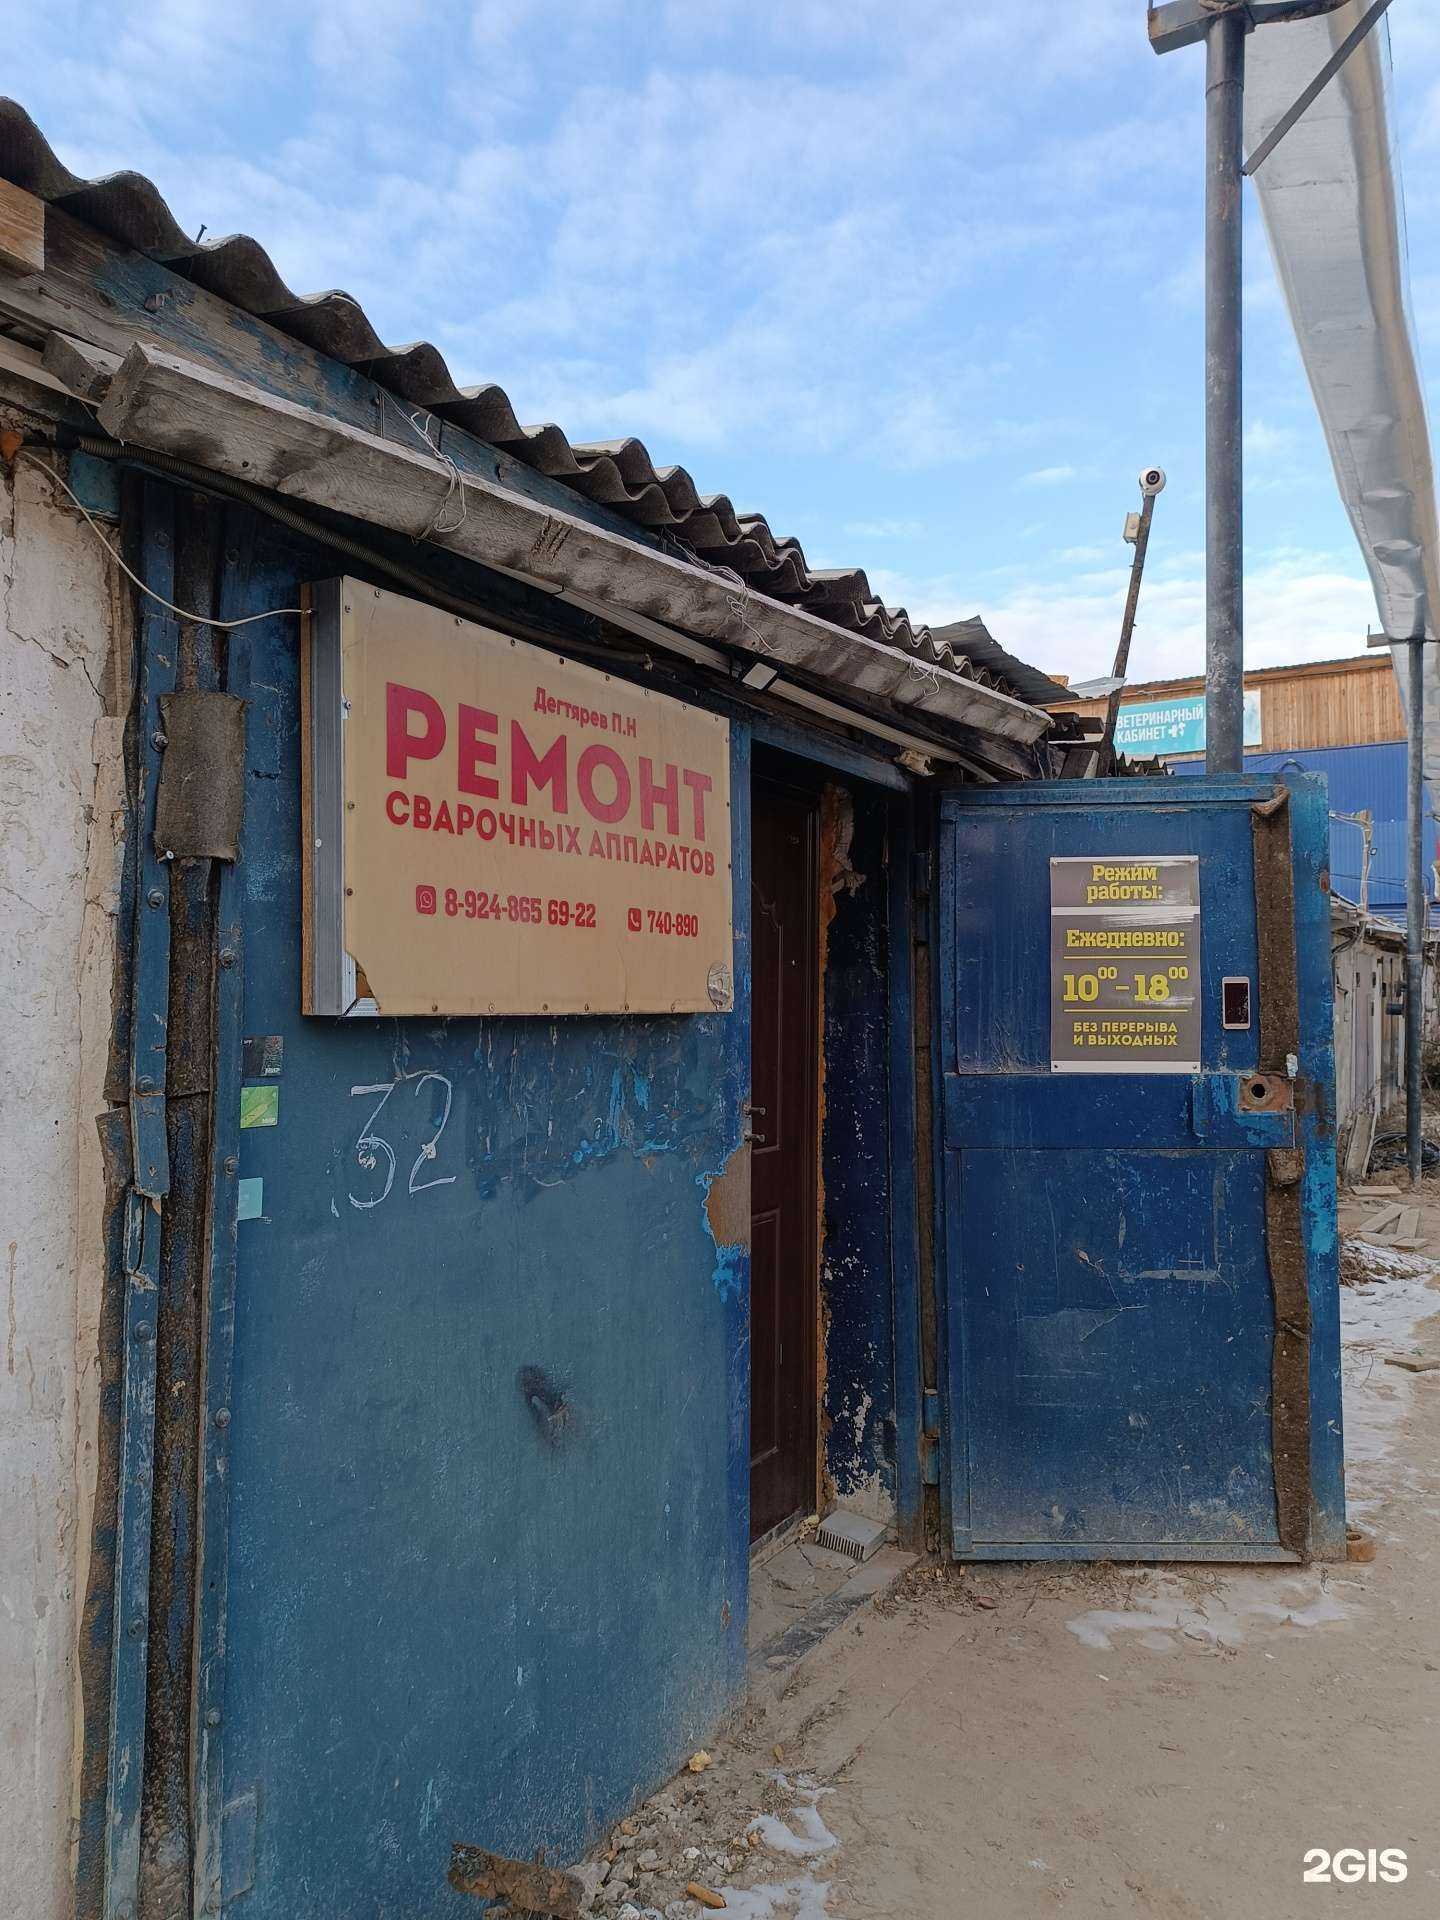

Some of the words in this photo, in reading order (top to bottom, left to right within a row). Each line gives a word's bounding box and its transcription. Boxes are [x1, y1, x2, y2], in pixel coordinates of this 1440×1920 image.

[534, 686, 608, 730] Дегтярев
[1117, 704, 1203, 729] ВЕТЕРИНАРНЫЙ
[1117, 726, 1166, 744] КАБИНЕТ
[386, 681, 713, 842] РЕМОНТ
[386, 790, 582, 856] СВАРОЧНЫХ
[588, 829, 715, 877] АППАРАТОВ
[1092, 864, 1157, 881] Режим
[1087, 881, 1163, 904] работы:
[444, 887, 542, 924] 8-924-865
[548, 899, 597, 928] 69-22
[647, 910, 699, 937] 740-890
[1066, 929, 1185, 948] Ежедневно:
[1073, 1022, 1098, 1032] БЕЗ
[1101, 1022, 1178, 1033] ПЕРЕРЫВА
[1073, 1035, 1083, 1046] И
[1088, 1035, 1178, 1047] ВЫХОДНЫХ
[349, 1072, 456, 1209] 32
